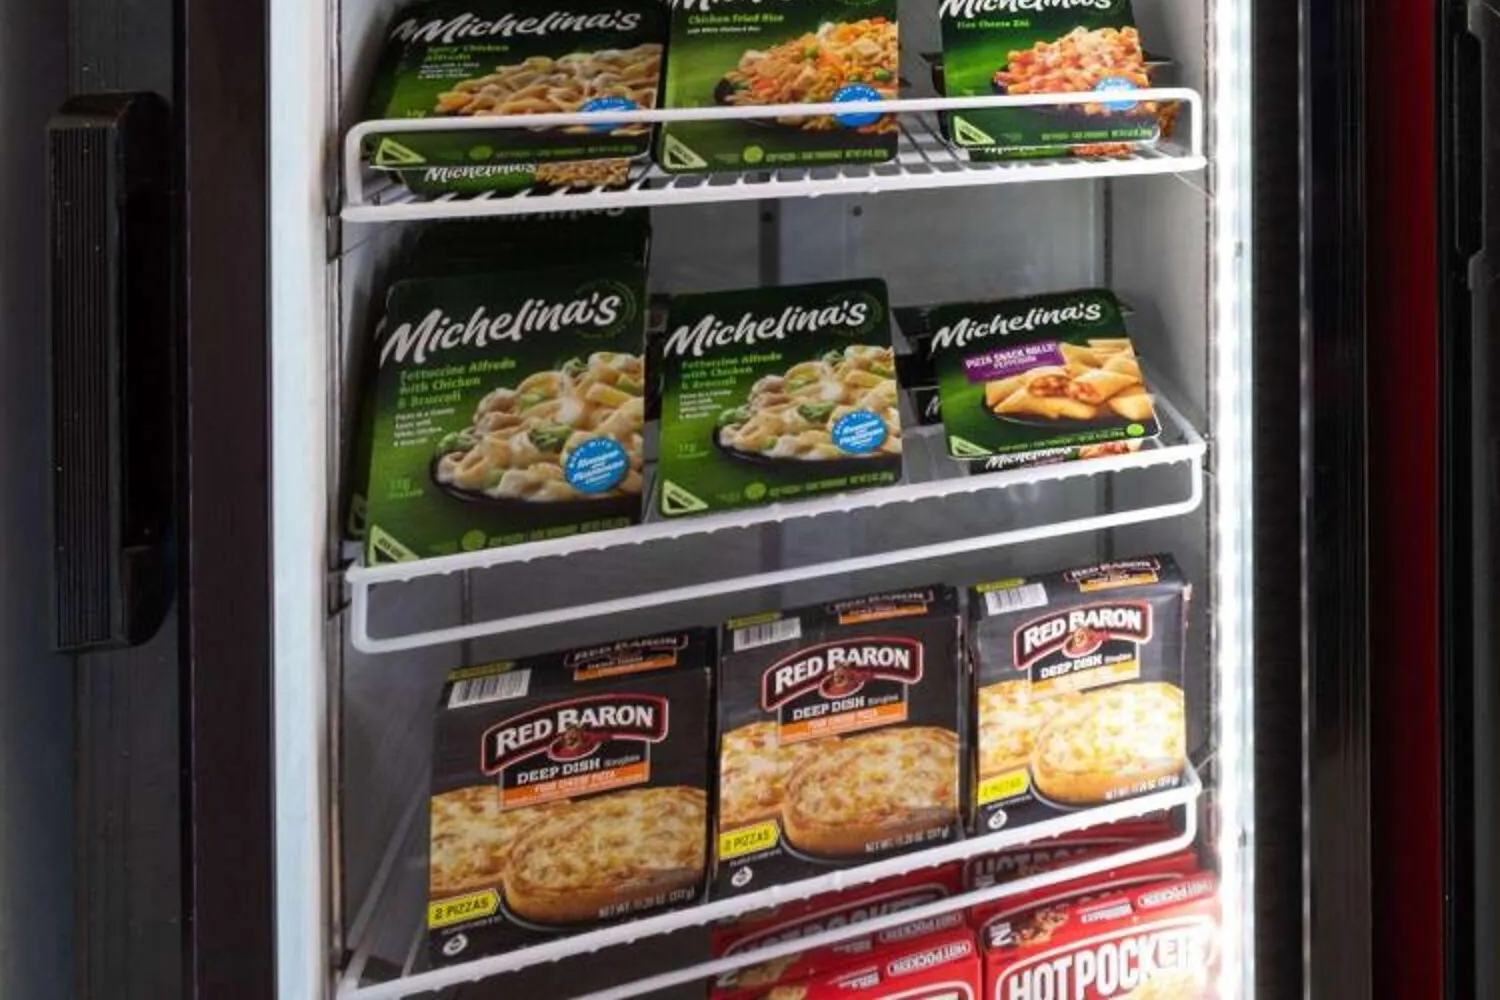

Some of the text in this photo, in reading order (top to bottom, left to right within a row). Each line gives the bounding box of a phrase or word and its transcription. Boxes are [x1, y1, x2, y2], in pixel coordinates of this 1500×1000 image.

[411, 10, 641, 43] Michelina's
[380, 293, 622, 369] Michelina's
[663, 301, 867, 356] Michelina's
[932, 304, 1101, 352] Michelina's
[1024, 608, 1141, 655] RED BARON
[775, 647, 911, 694] RED BARON
[1040, 663, 1073, 679] DEEP
[1074, 655, 1103, 671] DISH
[793, 705, 830, 721] DEEP
[832, 696, 865, 712] DISH
[496, 705, 654, 758] RED BARON
[516, 766, 560, 785] DEEP
[562, 758, 600, 775] DISH
[434, 896, 490, 920] 2 PIZZAS
[1008, 958, 1073, 1000] HOT
